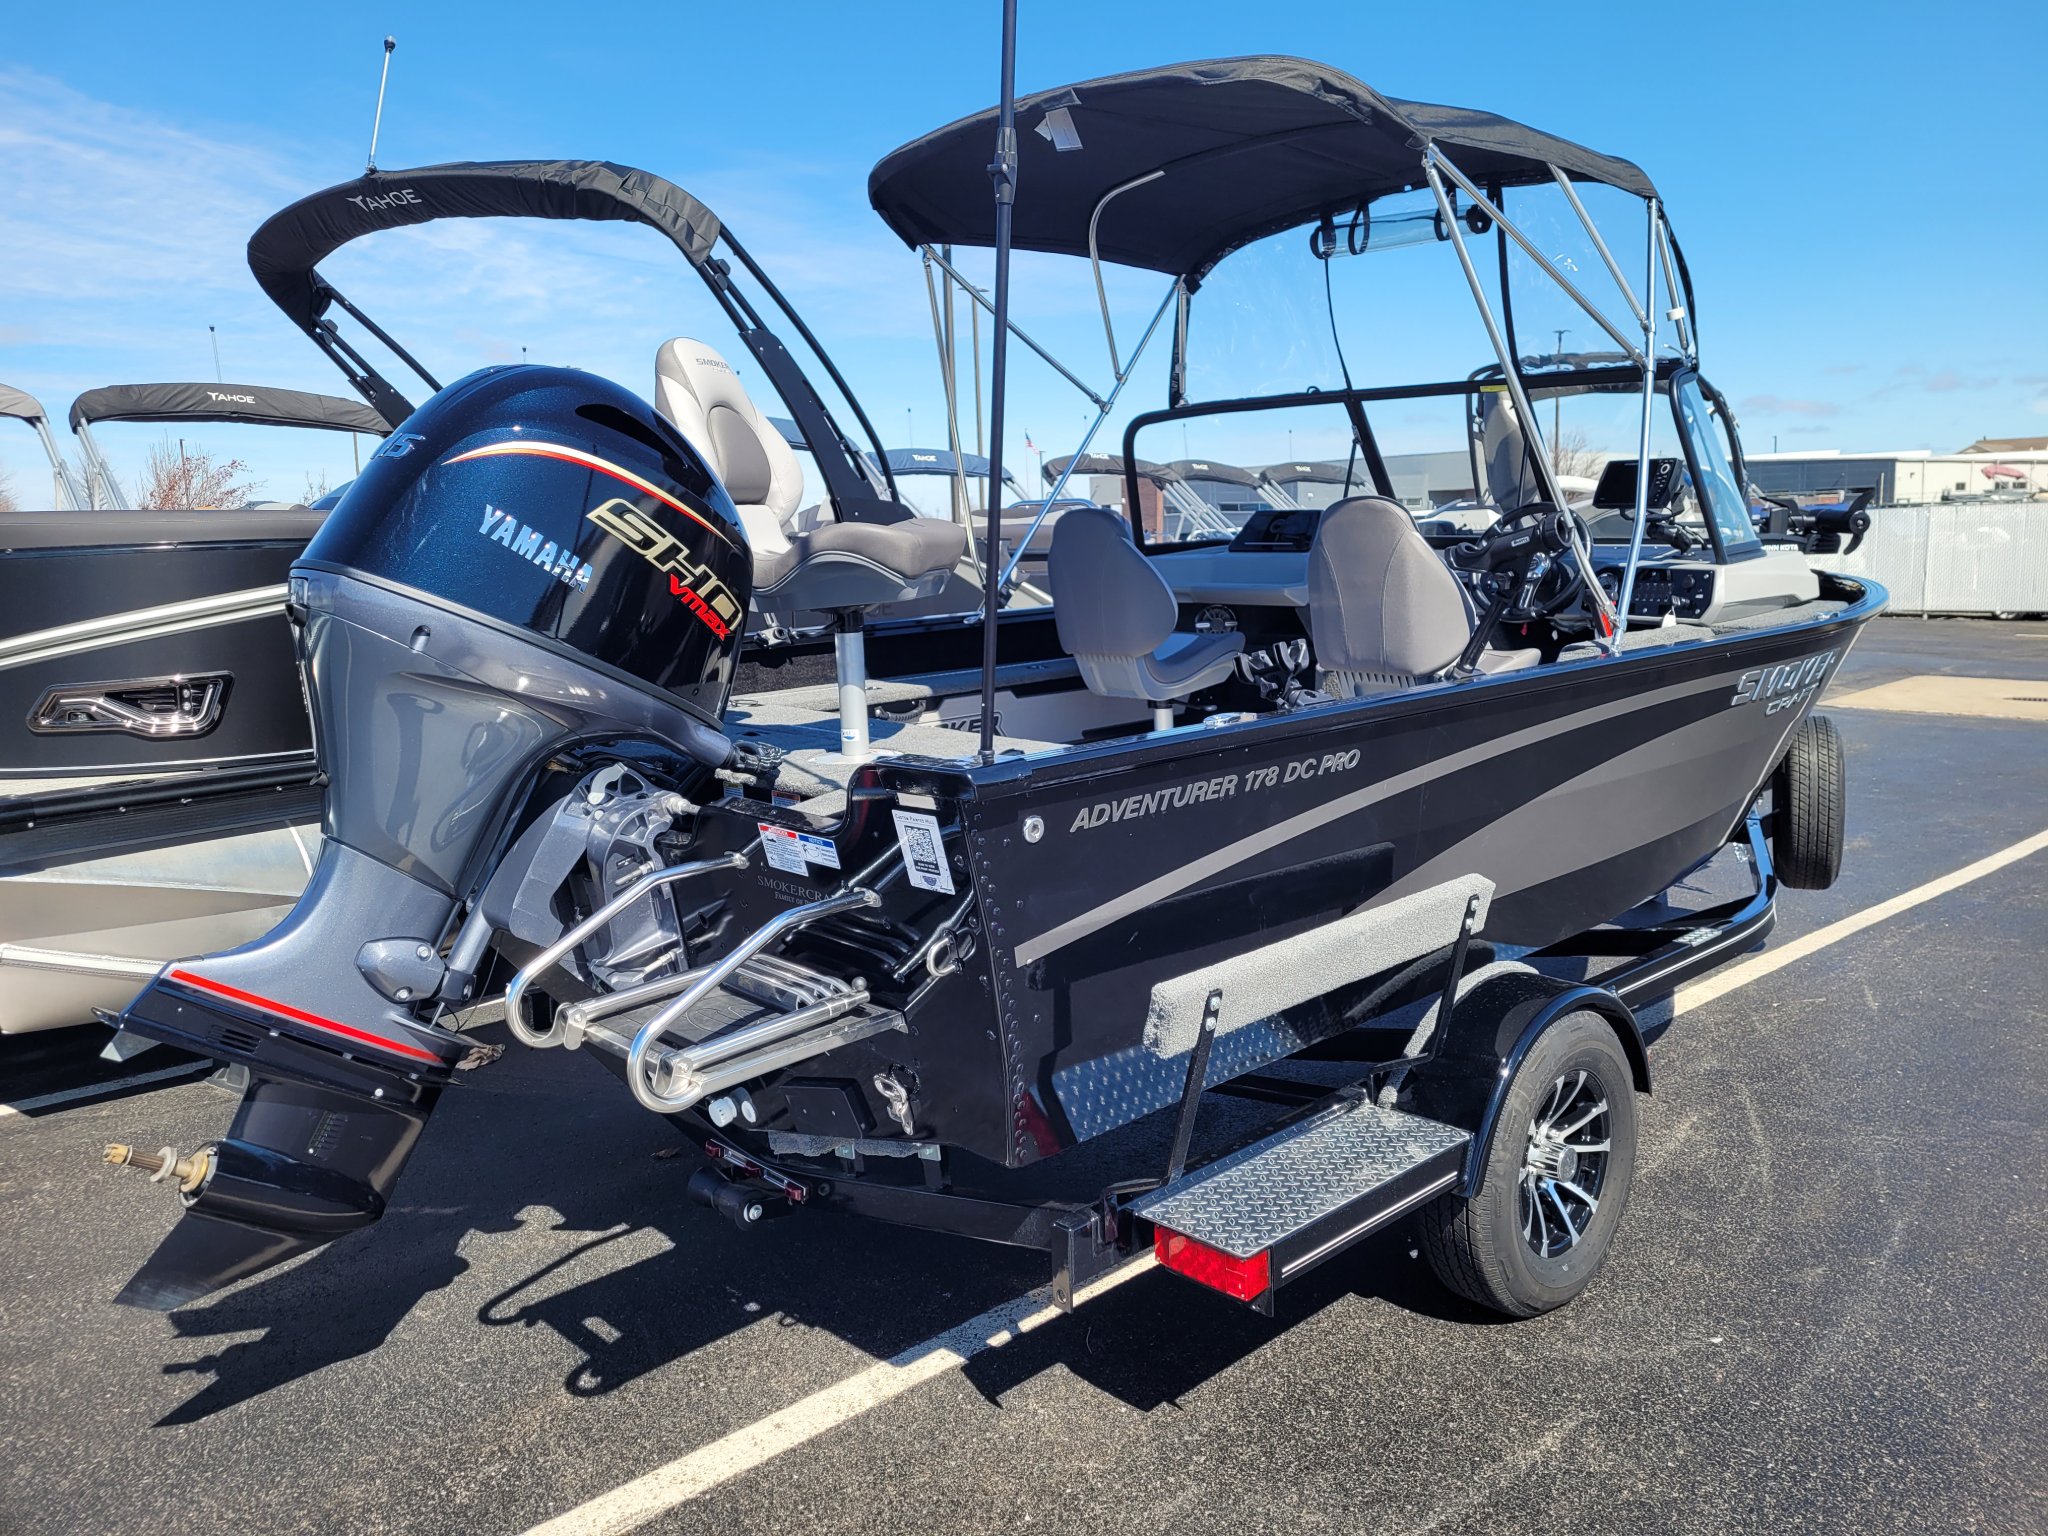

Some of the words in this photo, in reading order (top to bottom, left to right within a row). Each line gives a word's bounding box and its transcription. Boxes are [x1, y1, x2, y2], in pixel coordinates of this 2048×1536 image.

[345, 189, 423, 213] TAHOE
[206, 391, 256, 404] TAHOE
[479, 504, 593, 594] YAMAHA
[1069, 774, 1239, 833] ADVENTURER
[1244, 765, 1280, 793] 178
[1283, 758, 1318, 783] DC
[1318, 749, 1361, 776] PRO
[757, 875, 830, 901] SMOKERCRA
